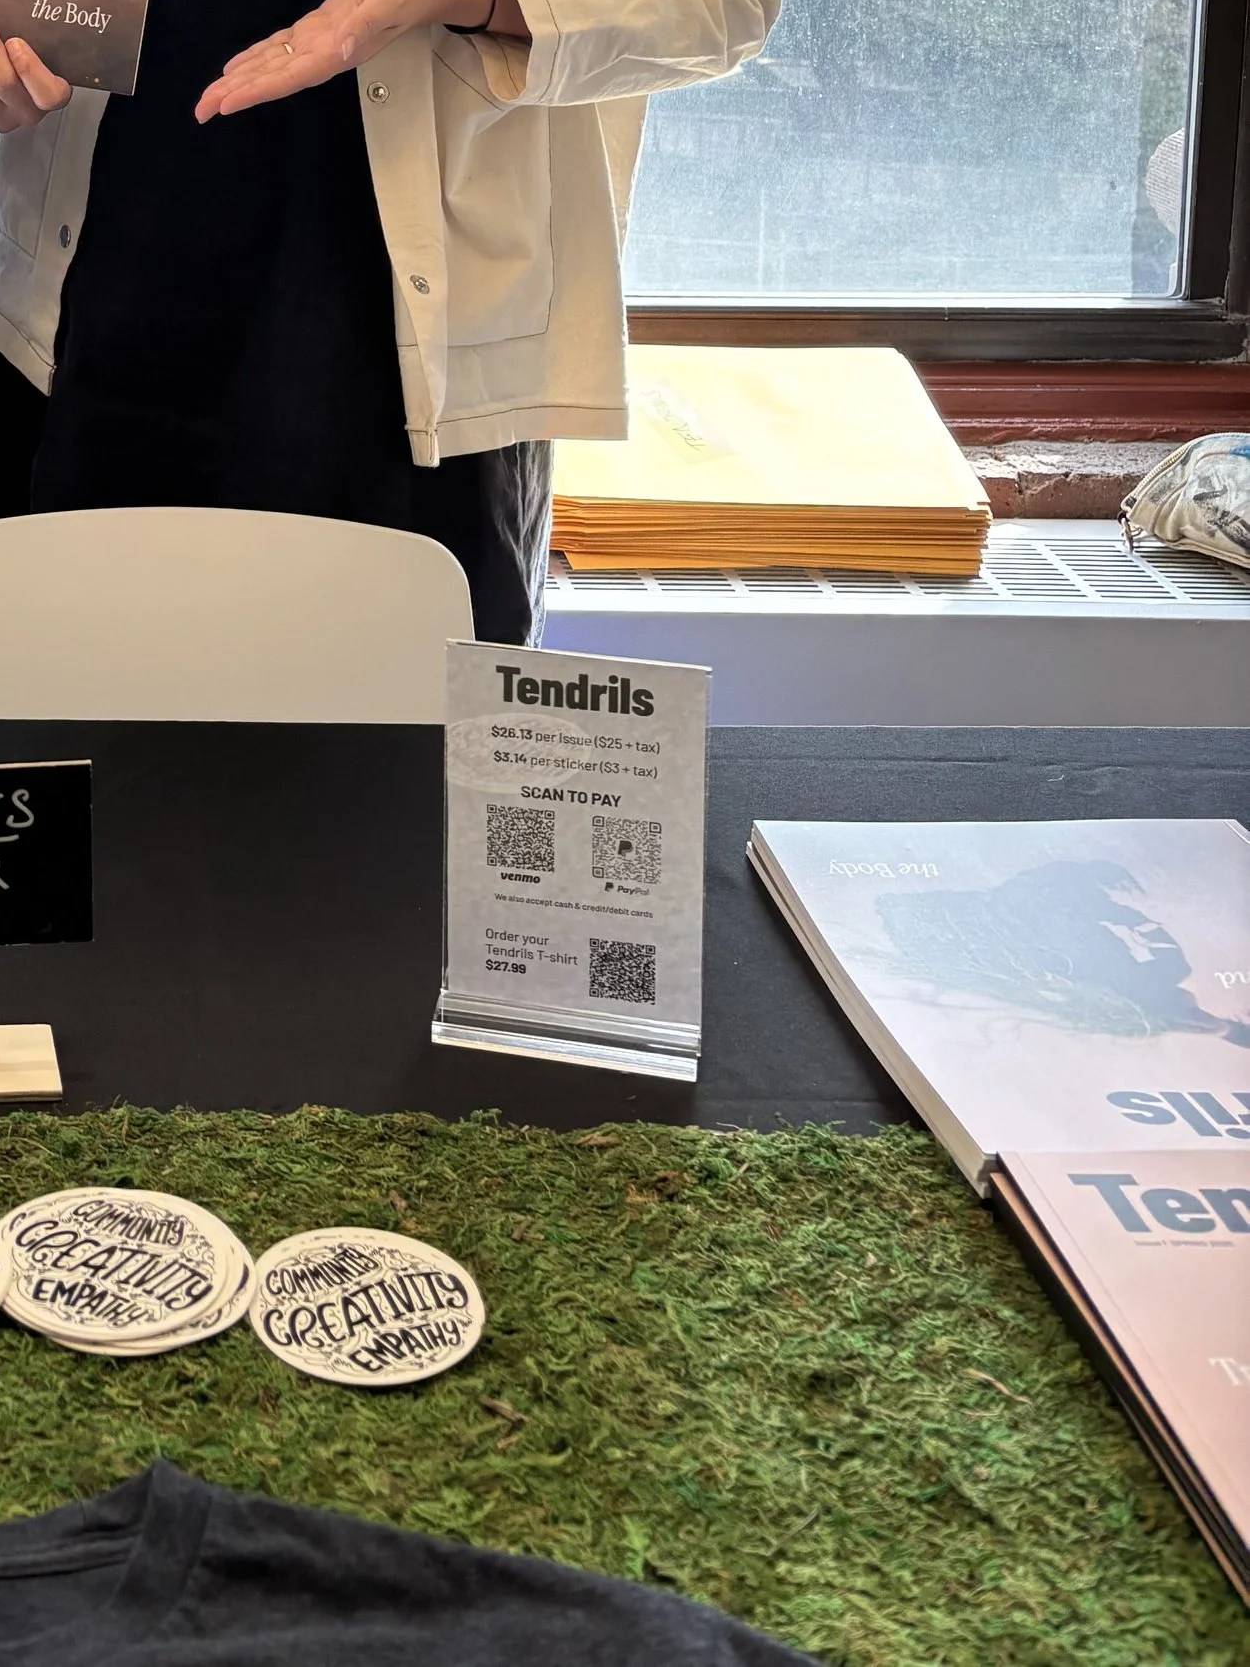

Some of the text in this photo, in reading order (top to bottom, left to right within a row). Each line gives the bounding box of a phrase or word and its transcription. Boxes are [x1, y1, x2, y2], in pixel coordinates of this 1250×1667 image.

[64, 2, 112, 33] Body
[495, 665, 655, 717] Tendrils
[491, 725, 533, 740] $26.13
[535, 732, 556, 746] per
[594, 736, 623, 750] ($25
[625, 742, 633, 750] +
[636, 741, 661, 755] tax)
[493, 750, 658, 779] $3.14 per sticker ($3 + tax)
[520, 785, 622, 808] SCAN TO PAY
[500, 872, 541, 884] venmo
[829, 859, 940, 878] the Body
[617, 885, 650, 896] PayPal
[494, 893, 654, 919] We also accept cash & credit/debit cards
[485, 928, 550, 947] Order your
[485, 943, 578, 966] Tendrils T-shirt
[485, 959, 527, 974] $27.99
[1214, 970, 1250, 990] nd
[73, 1200, 185, 1246] COMMUNITY
[15, 1220, 213, 1310] CREATIVITY
[265, 1247, 379, 1296] COMMUNITY
[32, 1278, 147, 1328] EMPATHY
[262, 1271, 470, 1349] CREATIVITY
[350, 1321, 463, 1373] EMPATHY
